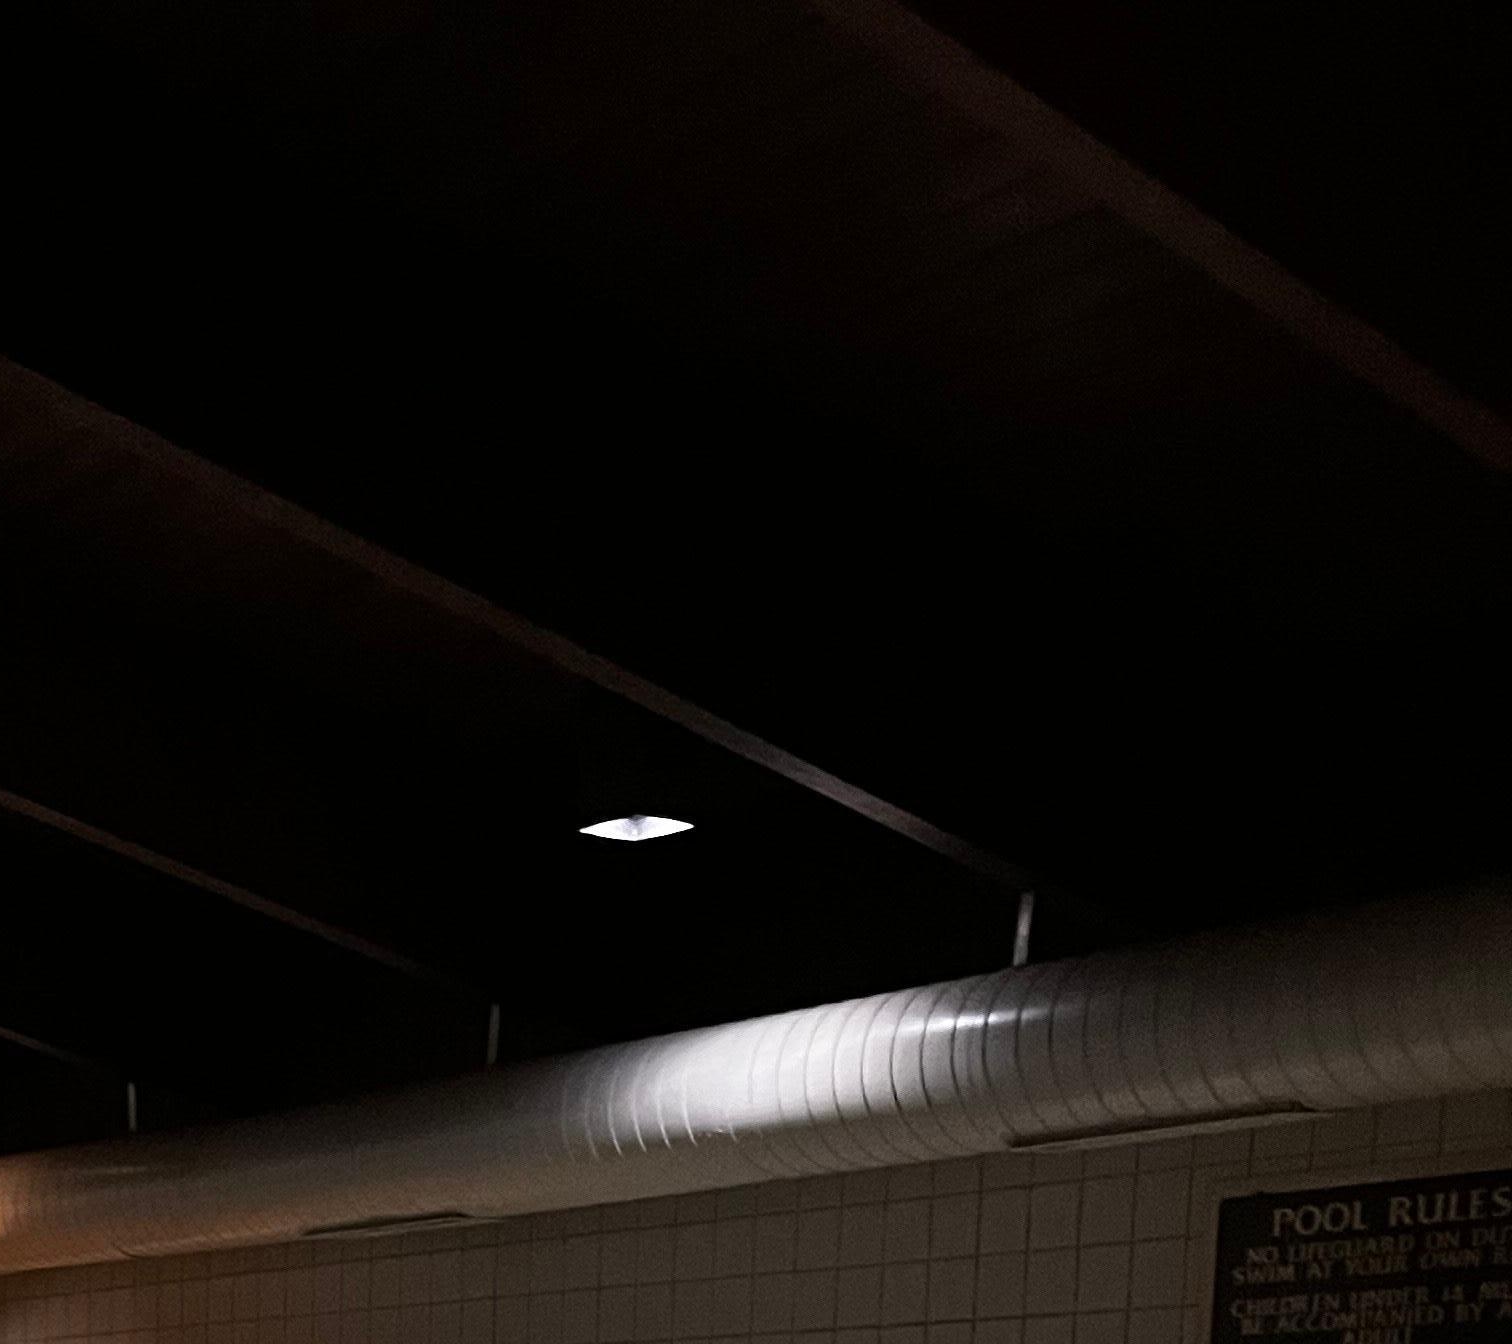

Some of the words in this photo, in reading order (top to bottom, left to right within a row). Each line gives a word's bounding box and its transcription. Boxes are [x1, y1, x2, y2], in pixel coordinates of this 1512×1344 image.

[1272, 1201, 1368, 1238] POOL
[1389, 1187, 1512, 1229] RULES
[1246, 1246, 1279, 1265] NO
[1425, 1229, 1460, 1249] ON
[1306, 1260, 1333, 1280] AT
